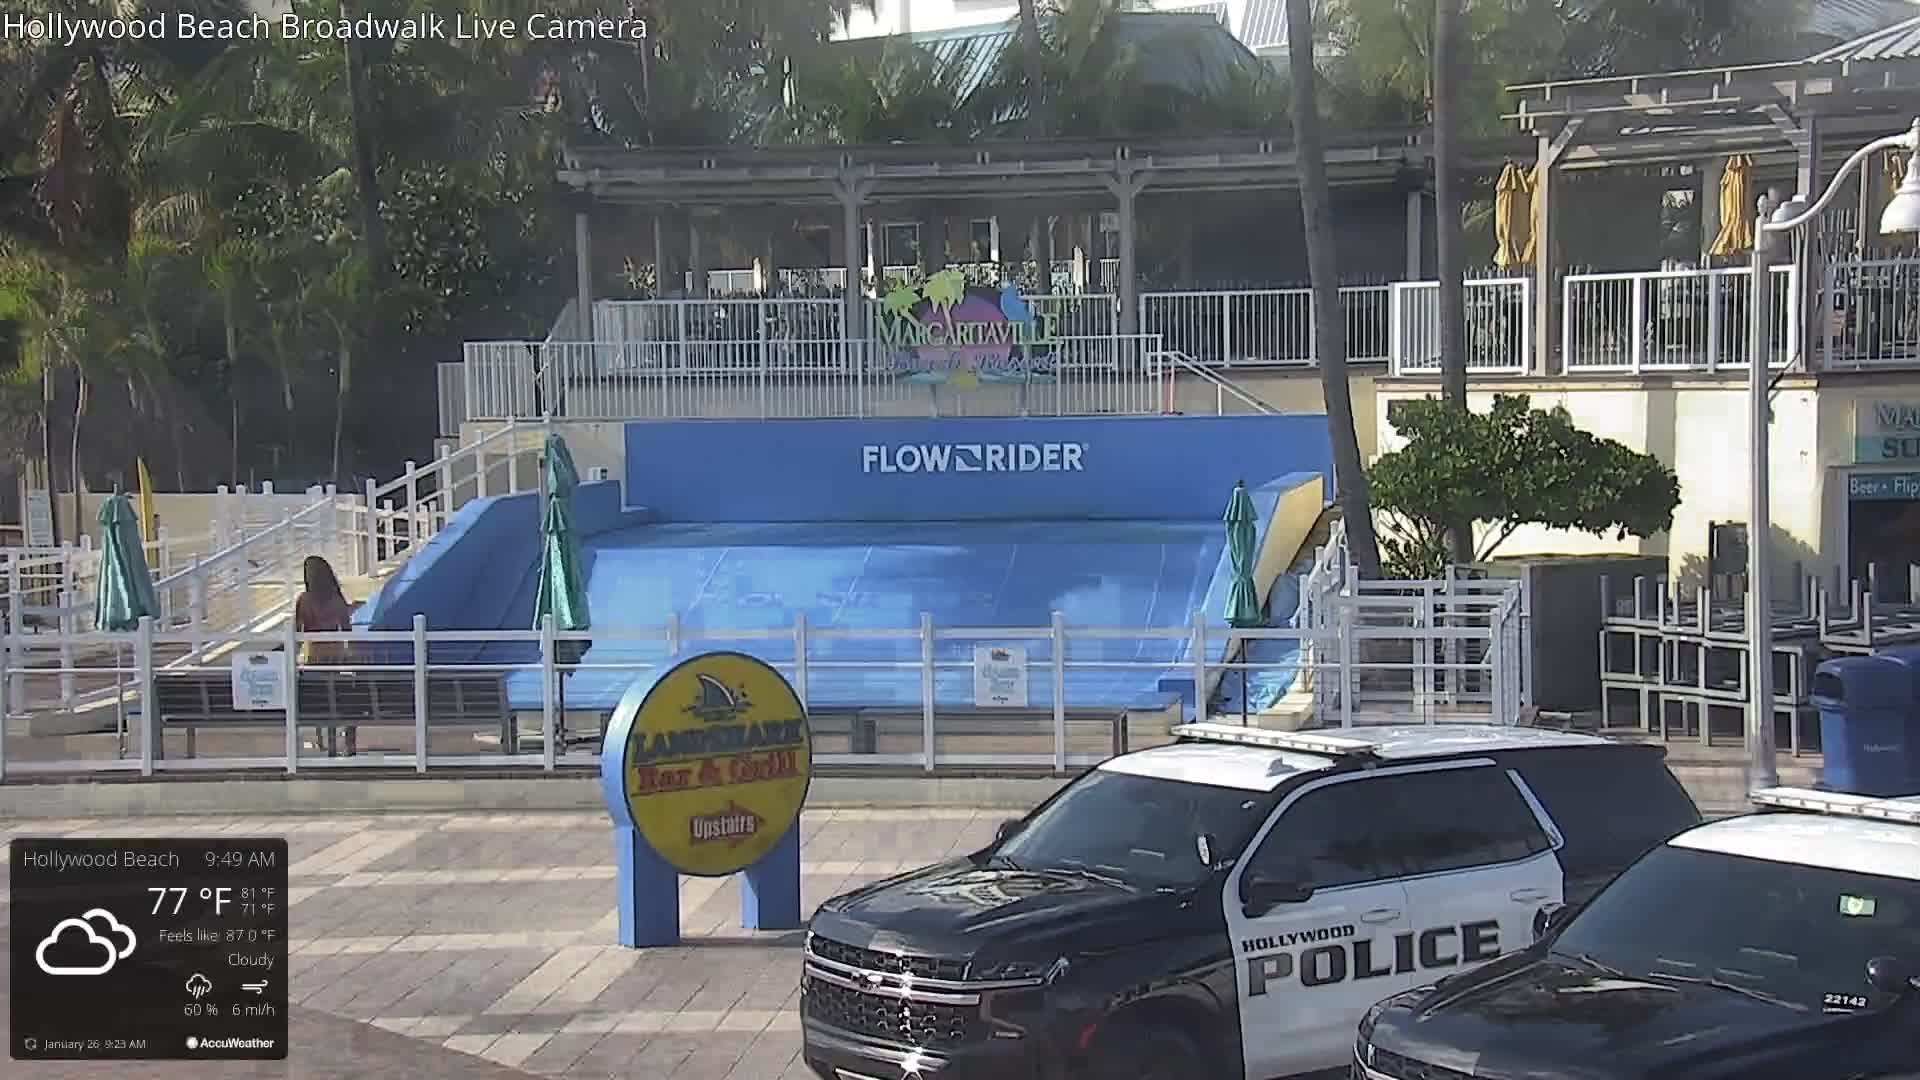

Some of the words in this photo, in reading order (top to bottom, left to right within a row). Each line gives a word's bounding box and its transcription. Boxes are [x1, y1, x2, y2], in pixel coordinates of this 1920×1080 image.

[876, 312, 1058, 345] MARGARITAVILLE
[1850, 478, 1877, 494] Beer
[638, 763, 692, 792] Bar
[729, 751, 801, 784] Grill
[693, 815, 755, 840] Upstairs
[1241, 924, 1355, 952] HOLLYWOOD
[1247, 919, 1501, 997] POLICE
